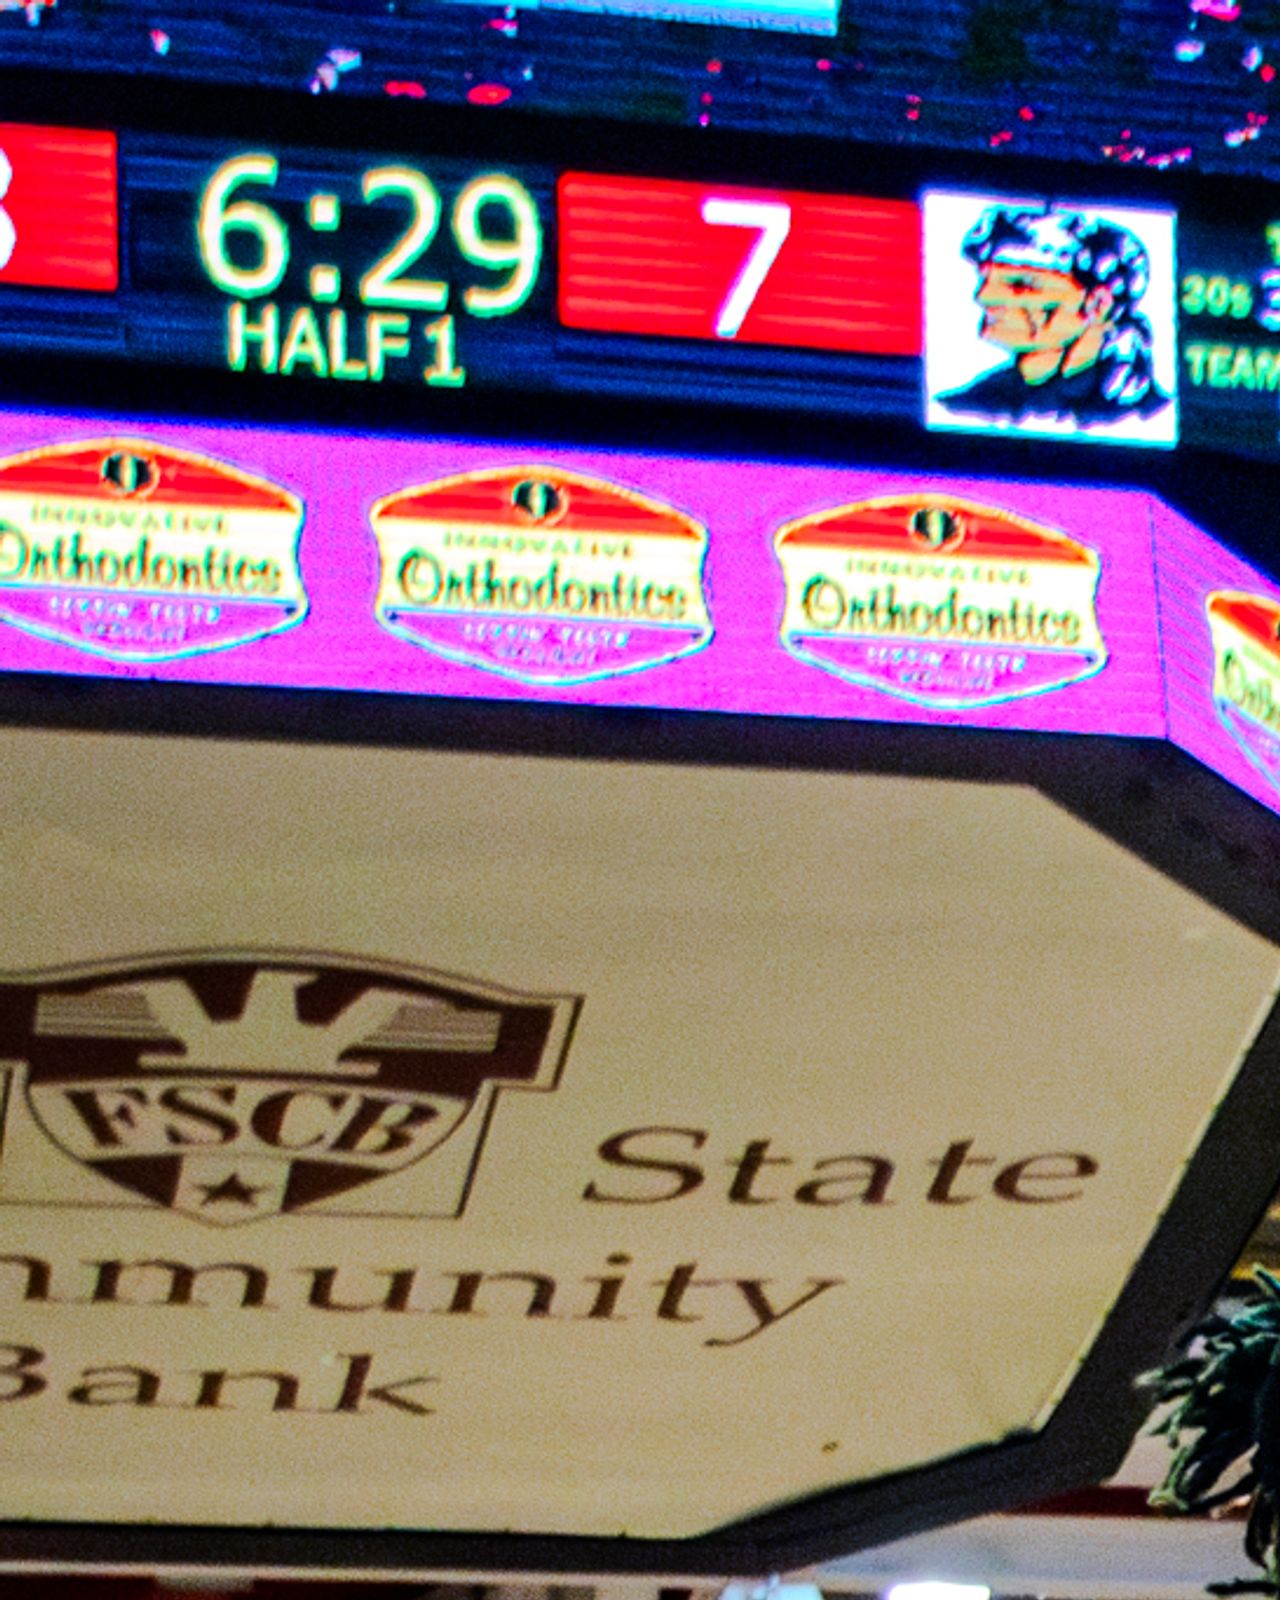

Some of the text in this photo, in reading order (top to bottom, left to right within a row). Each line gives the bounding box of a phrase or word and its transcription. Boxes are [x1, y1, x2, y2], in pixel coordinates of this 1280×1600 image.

[199, 154, 543, 318] 6:29
[700, 198, 792, 338] 7
[227, 302, 467, 389] HALF 1
[399, 547, 687, 619] Orthodontics
[801, 573, 1081, 645] Orthodontics
[64, 1084, 442, 1155] FSCB
[582, 1124, 1100, 1207] State
